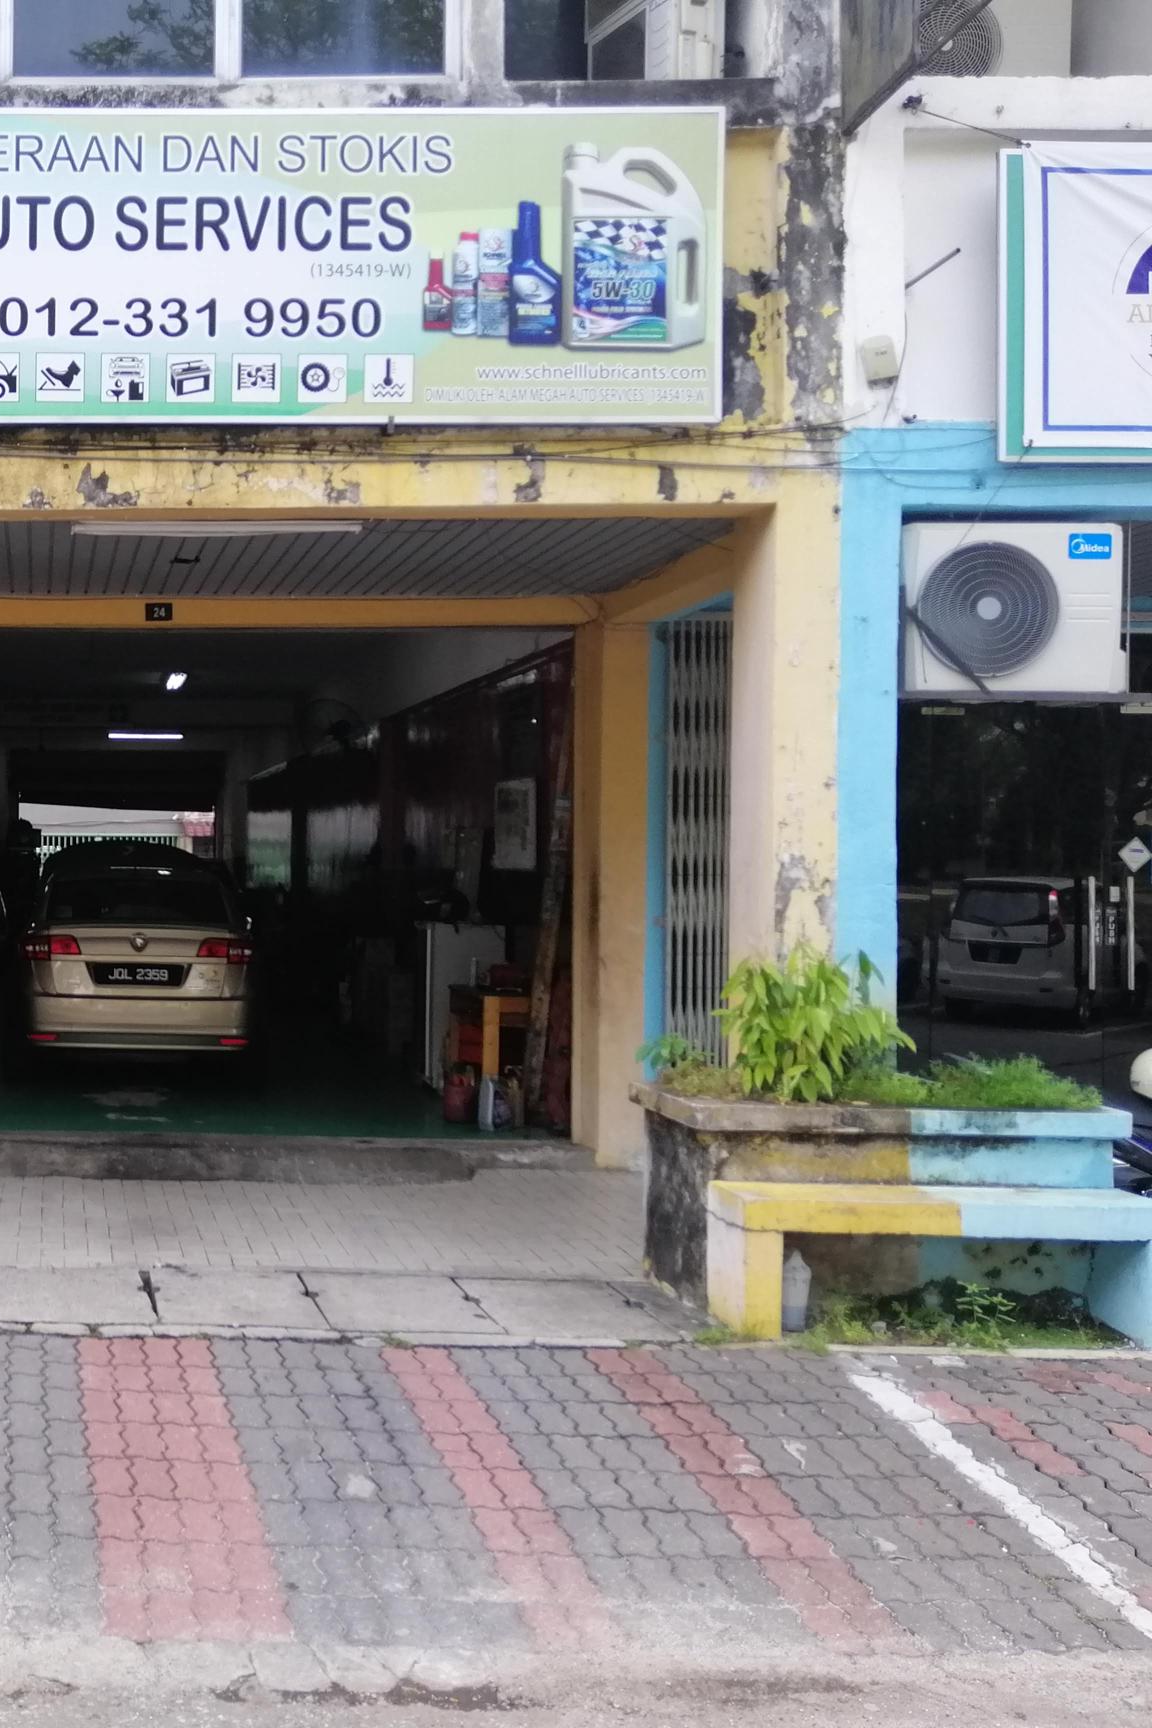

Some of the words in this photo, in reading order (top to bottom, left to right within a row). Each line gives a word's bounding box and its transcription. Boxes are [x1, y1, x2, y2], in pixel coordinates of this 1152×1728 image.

[162, 135, 259, 172] DAN
[278, 135, 452, 173] STOKIS
[115, 195, 413, 252] SERVICES
[311, 262, 412, 279] (1345419-W)
[591, 280, 656, 300] 5W-30
[0, 296, 218, 338] 012-331
[244, 297, 382, 338] 9950
[477, 364, 706, 380] www.schnelllubricants.com
[497, 387, 527, 402] ALAM
[528, 387, 567, 402] MEGAH
[153, 607, 166, 618] 24
[108, 968, 132, 980] JQL
[136, 968, 169, 981] 2359
